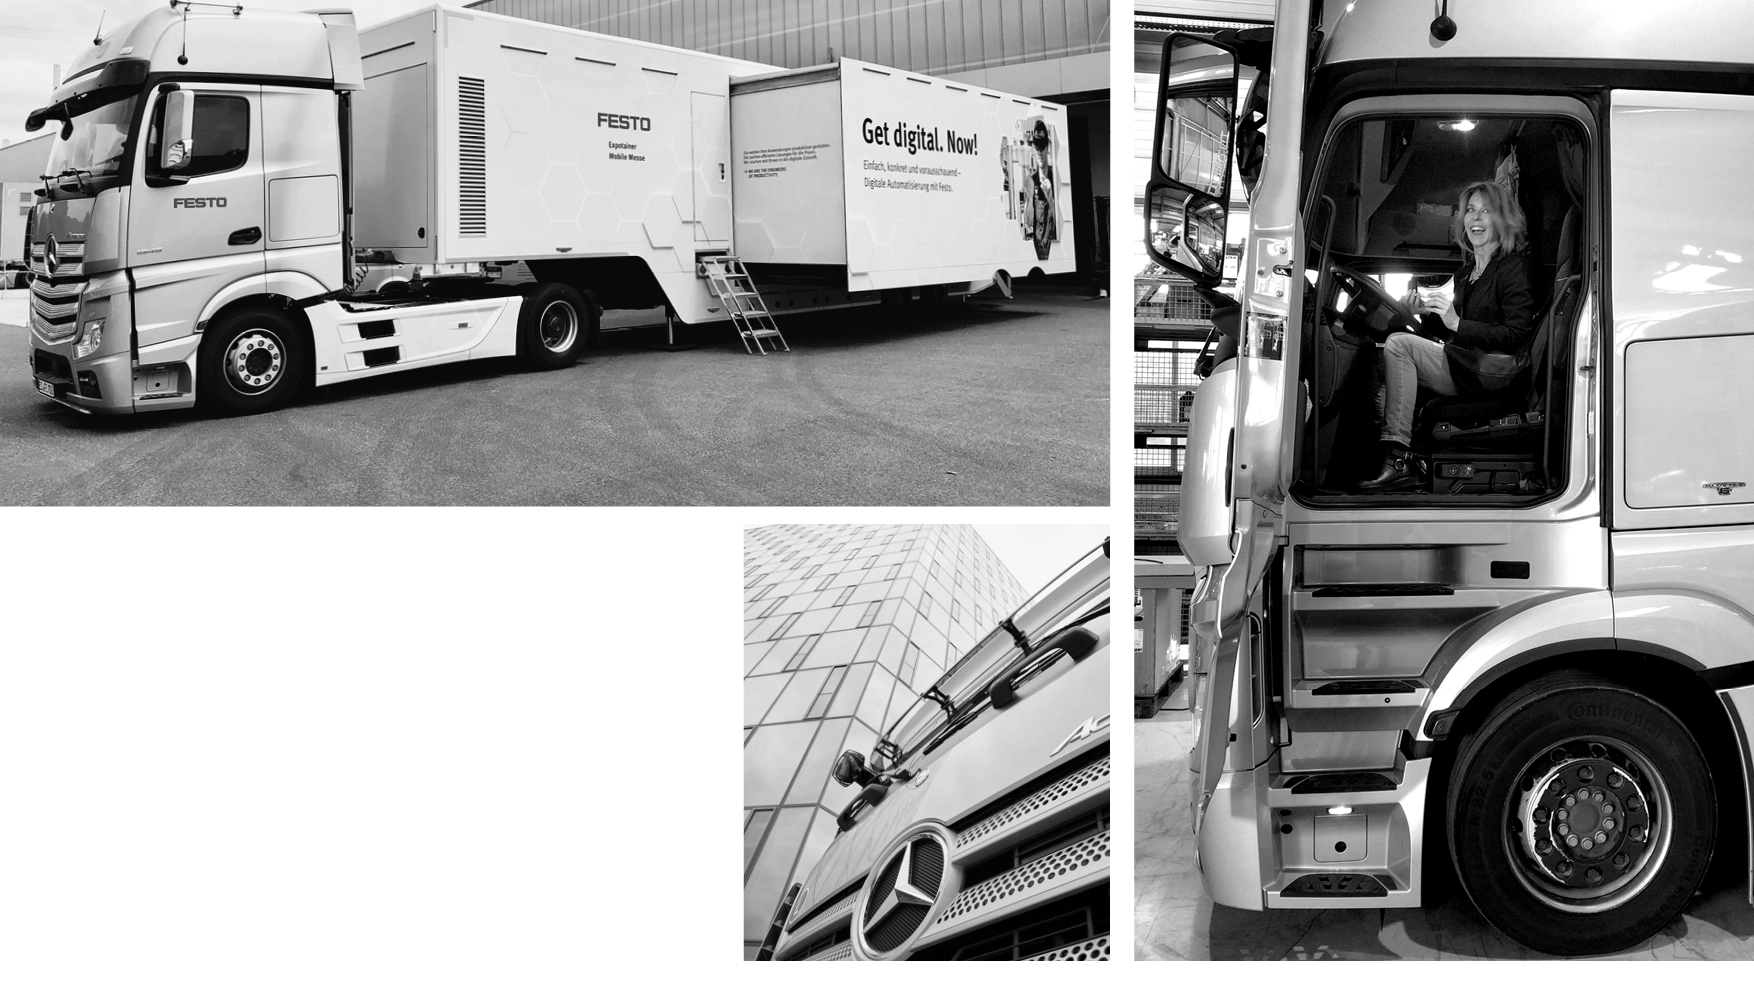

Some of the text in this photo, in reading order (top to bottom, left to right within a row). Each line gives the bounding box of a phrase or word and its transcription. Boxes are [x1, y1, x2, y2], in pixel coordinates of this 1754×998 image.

[598, 112, 650, 131] FESTO
[862, 118, 978, 156] Get digital. Now!
[608, 141, 636, 150] Expotainer
[864, 160, 886, 172] Einfach,
[887, 162, 907, 173] konkret
[908, 164, 918, 174] und
[919, 166, 957, 176] vorausschauend
[864, 177, 953, 193] Digitale Automatisierung mit Festo.
[174, 197, 227, 208] FESTO
